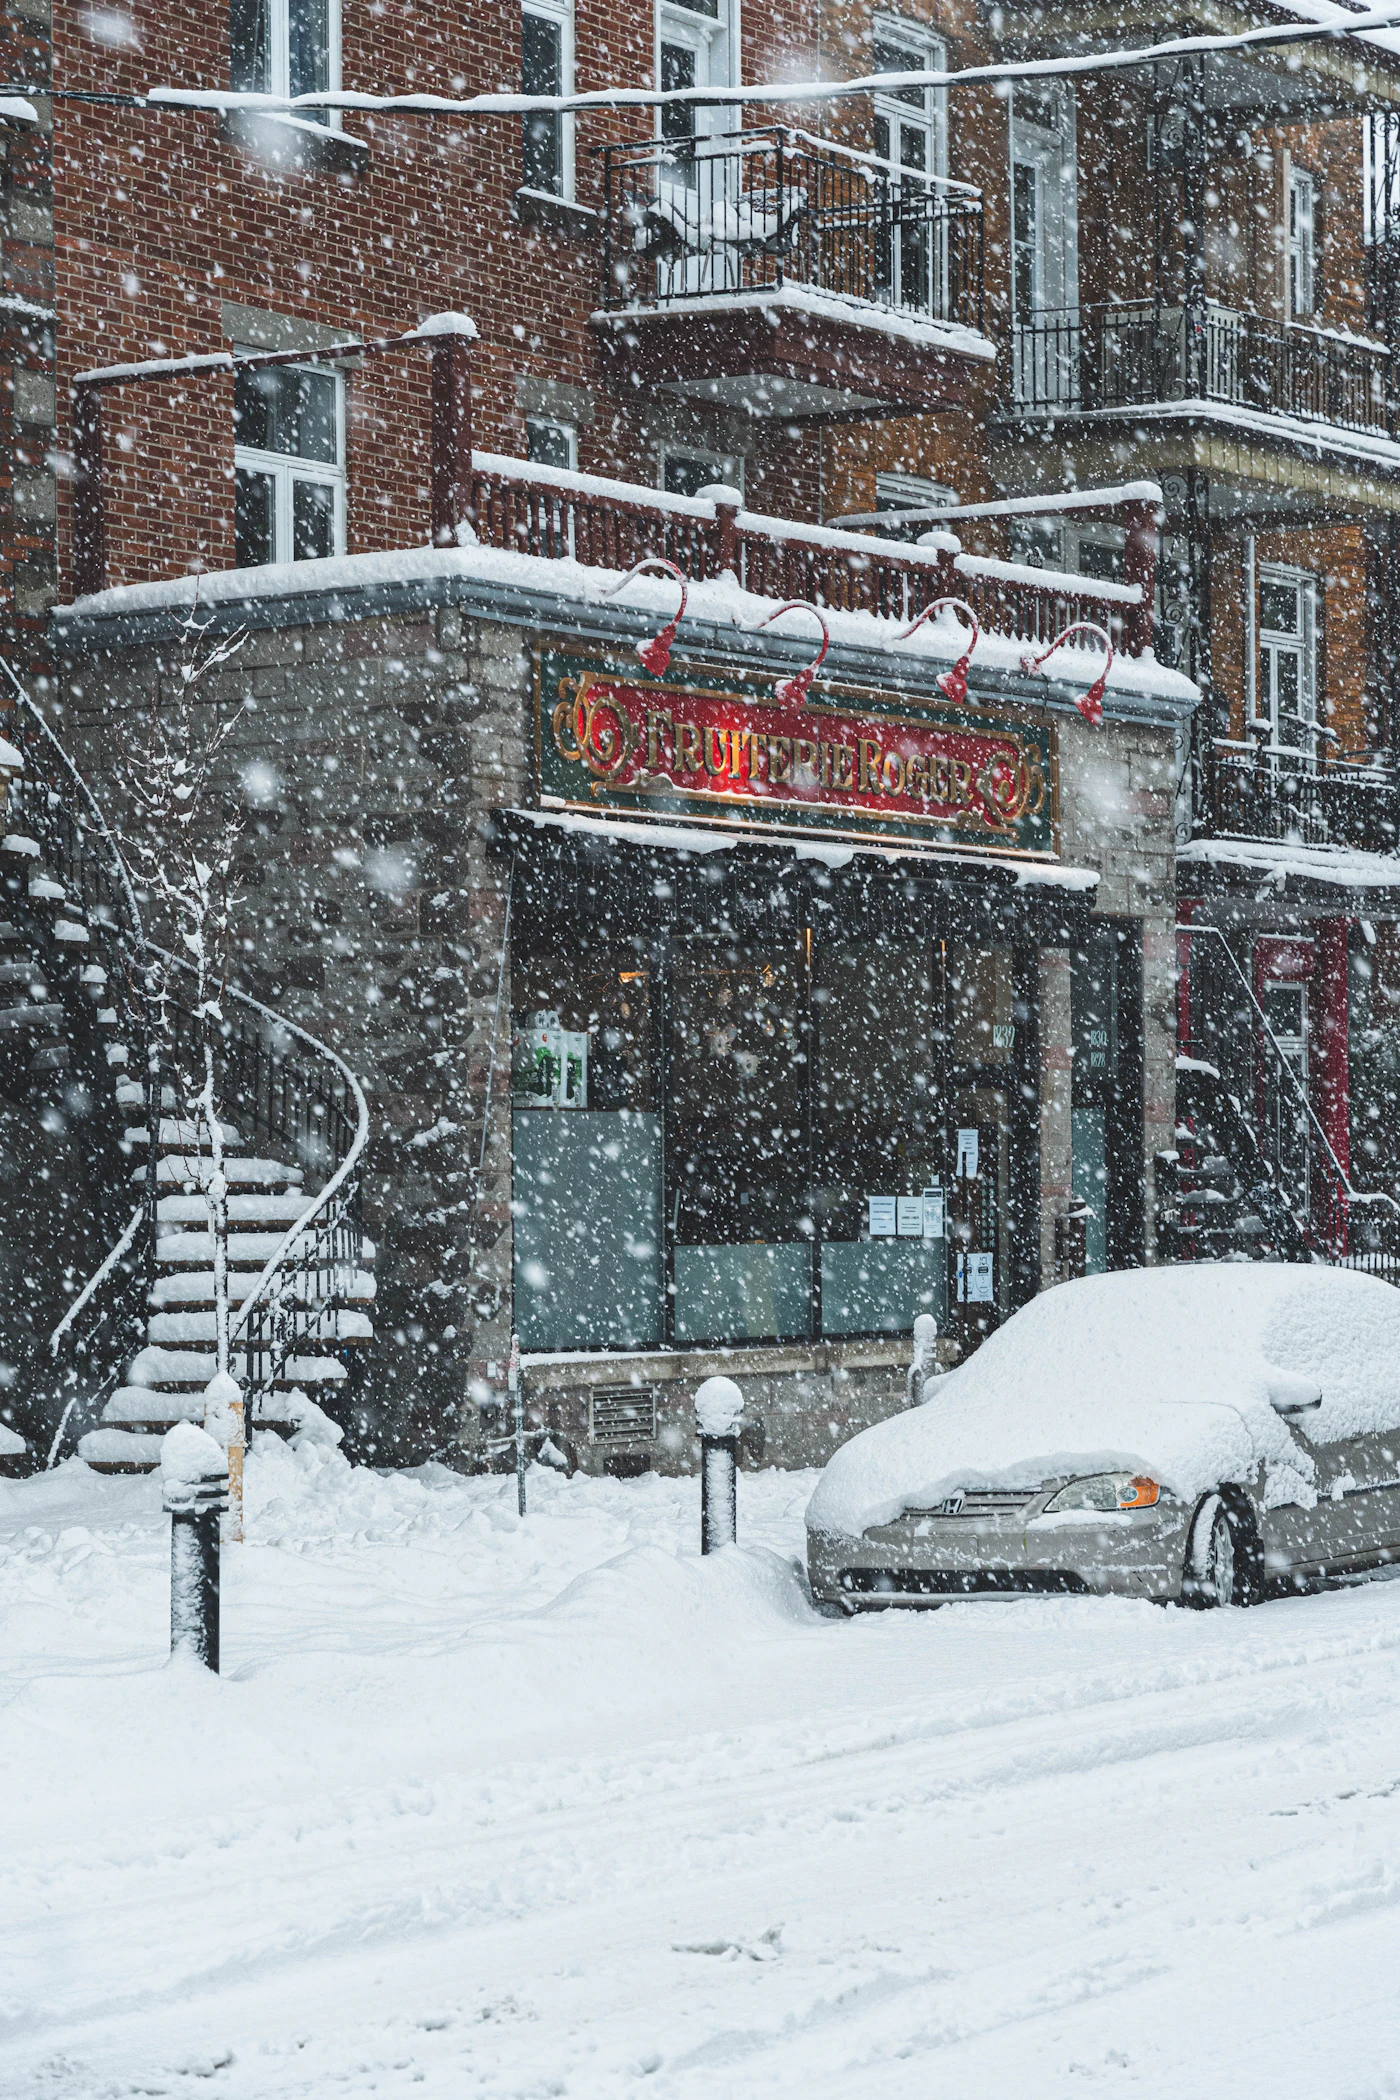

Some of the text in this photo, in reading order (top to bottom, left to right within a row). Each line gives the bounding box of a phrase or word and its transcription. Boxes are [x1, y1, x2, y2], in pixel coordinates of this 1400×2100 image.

[645, 710, 974, 804] FRUITERIE ROGER
[993, 1025, 1015, 1048] 1832
